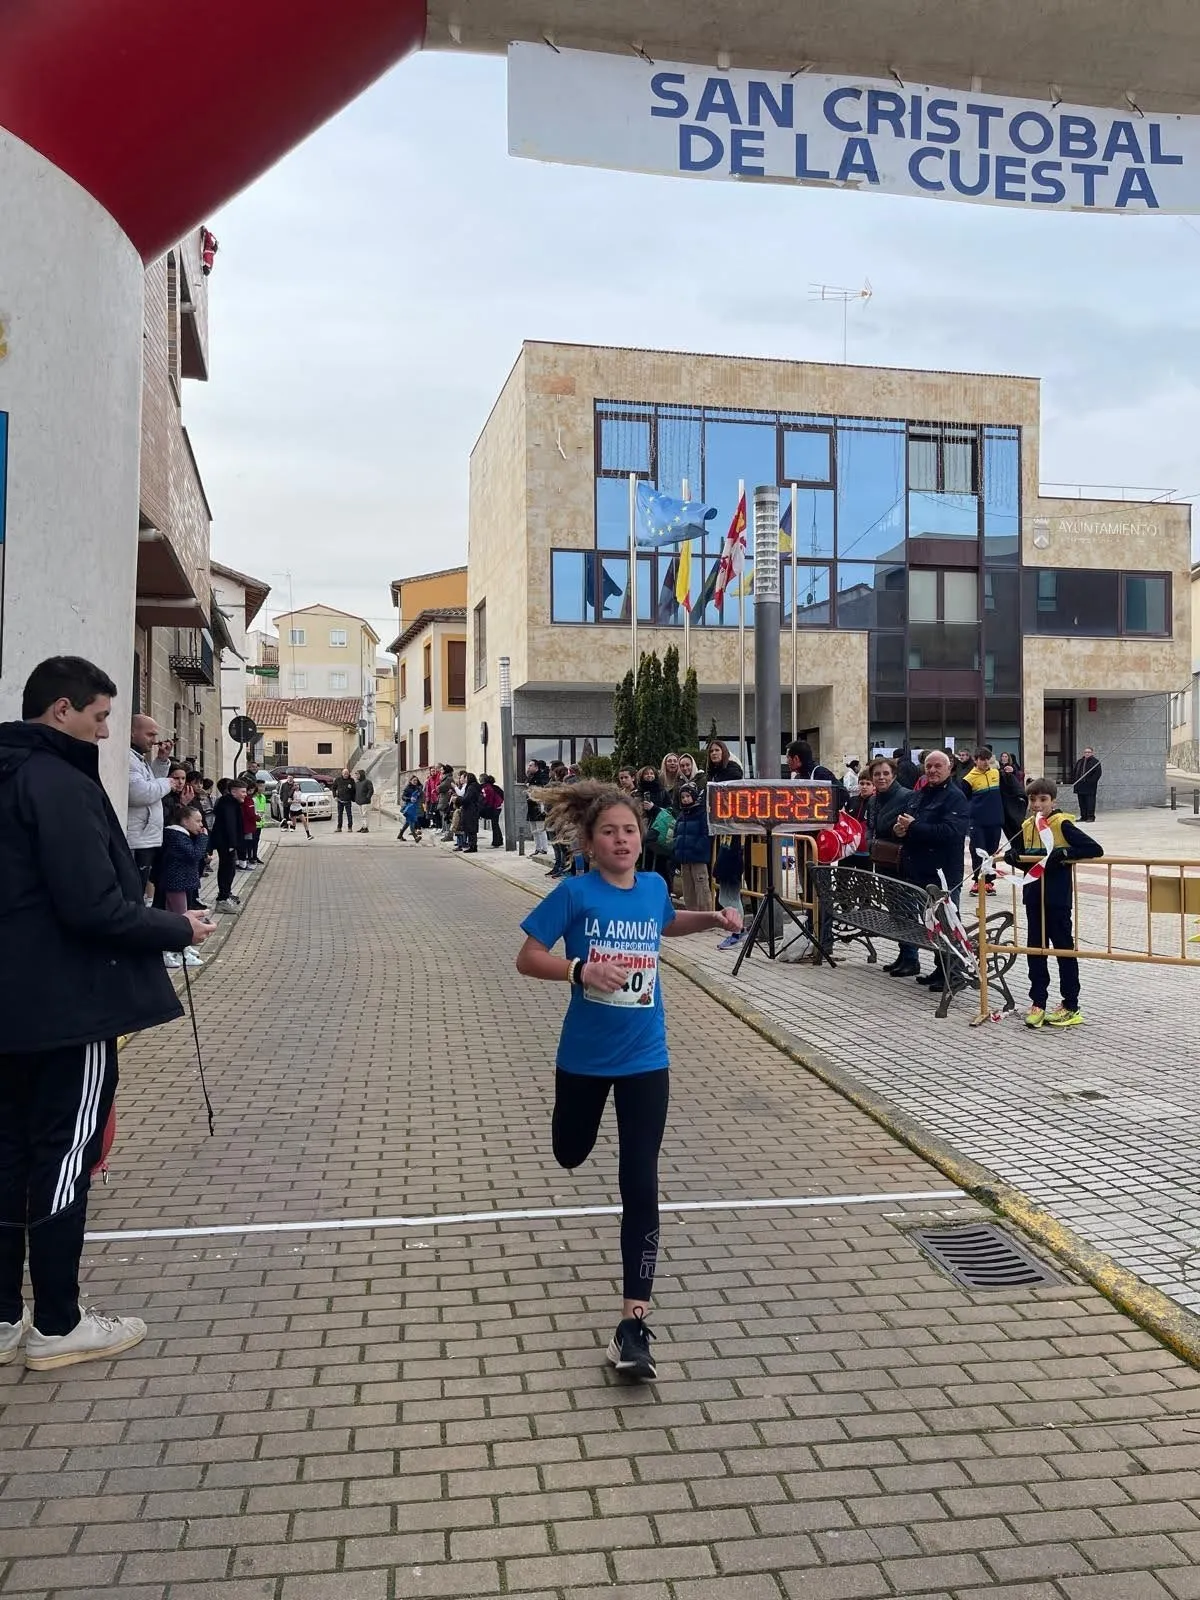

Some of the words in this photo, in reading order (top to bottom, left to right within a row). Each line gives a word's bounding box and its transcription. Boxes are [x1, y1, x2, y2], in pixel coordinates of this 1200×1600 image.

[650, 72, 794, 129] SAN
[823, 87, 1184, 165] CRISTOBAL
[679, 125, 765, 176] DE
[795, 133, 880, 185] LA
[908, 147, 1159, 209] CUESTA
[1058, 520, 1158, 537] AYUNTAMIENTO
[584, 917, 600, 936] LA
[605, 918, 658, 940] ARMUÑA
